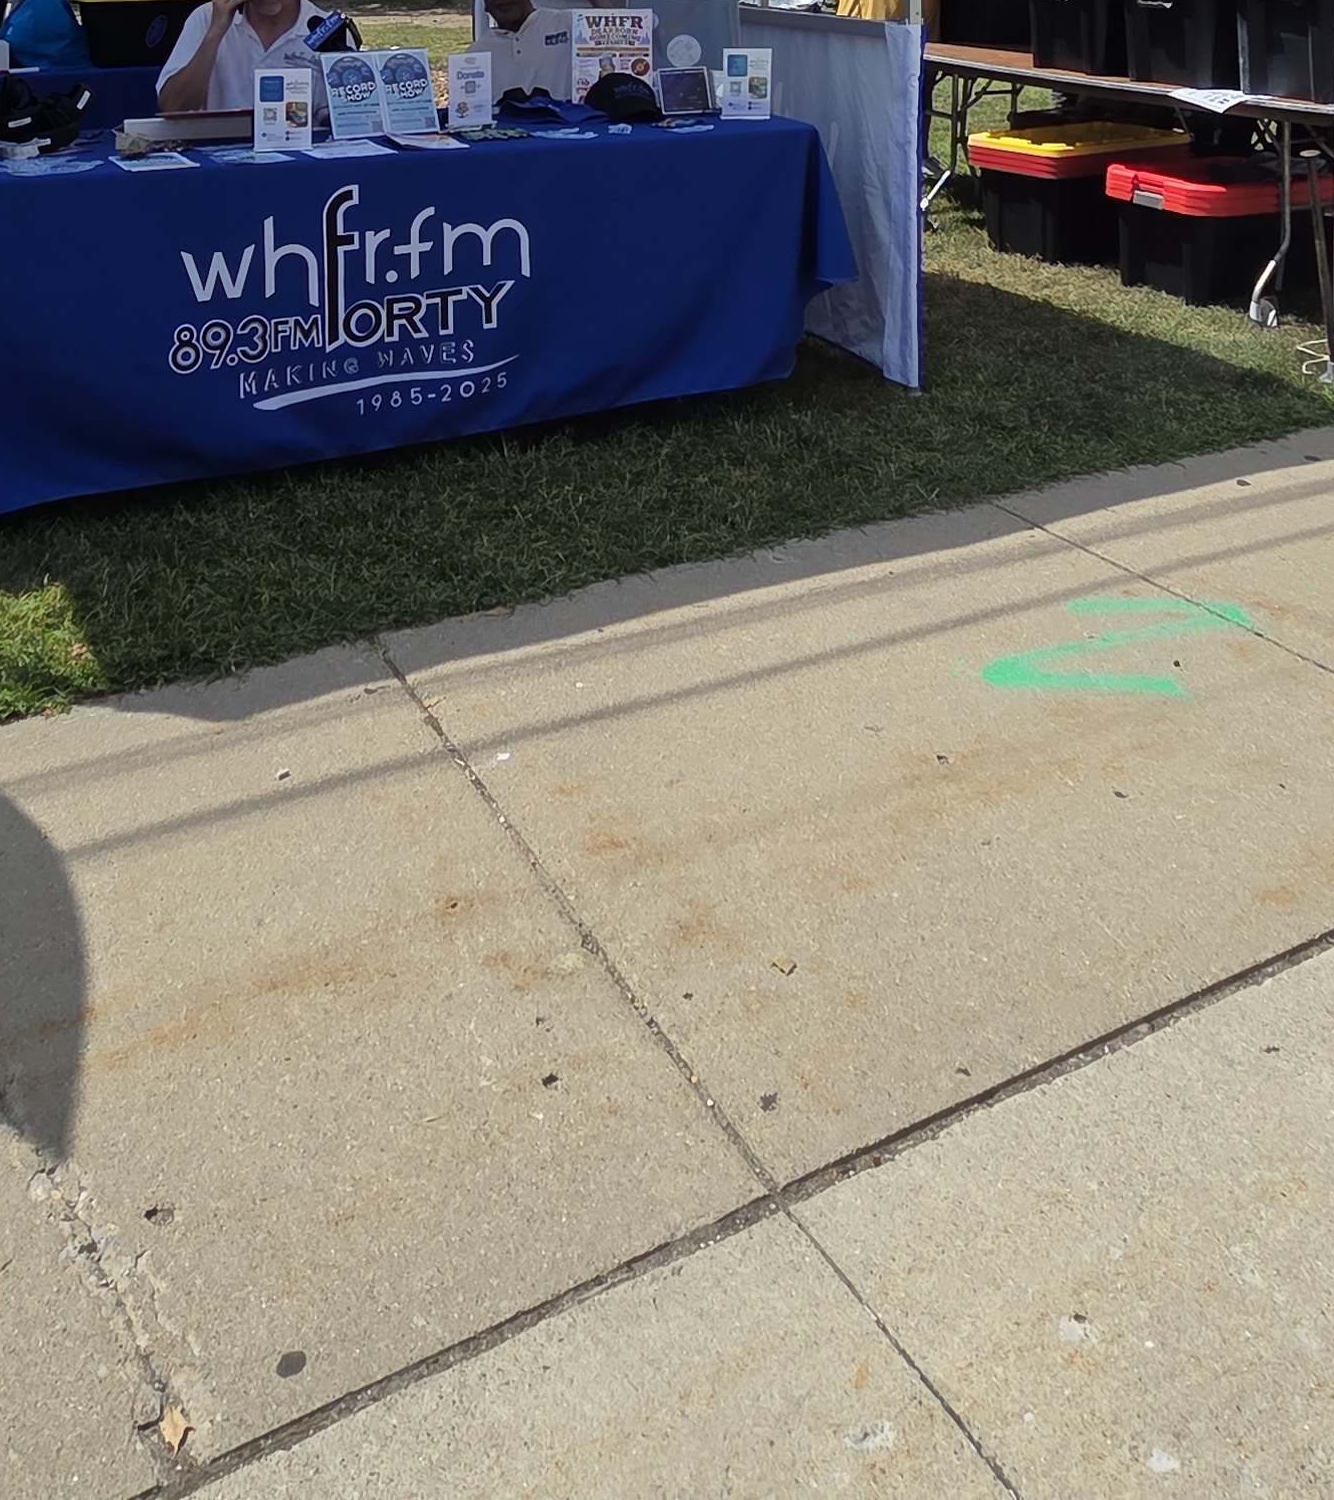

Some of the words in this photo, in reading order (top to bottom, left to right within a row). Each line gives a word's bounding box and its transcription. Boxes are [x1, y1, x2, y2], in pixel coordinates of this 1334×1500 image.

[585, 15, 643, 29] WHFR
[331, 81, 376, 98] RECORD
[385, 78, 428, 95] RECORD
[355, 371, 509, 416] 1985-2025
